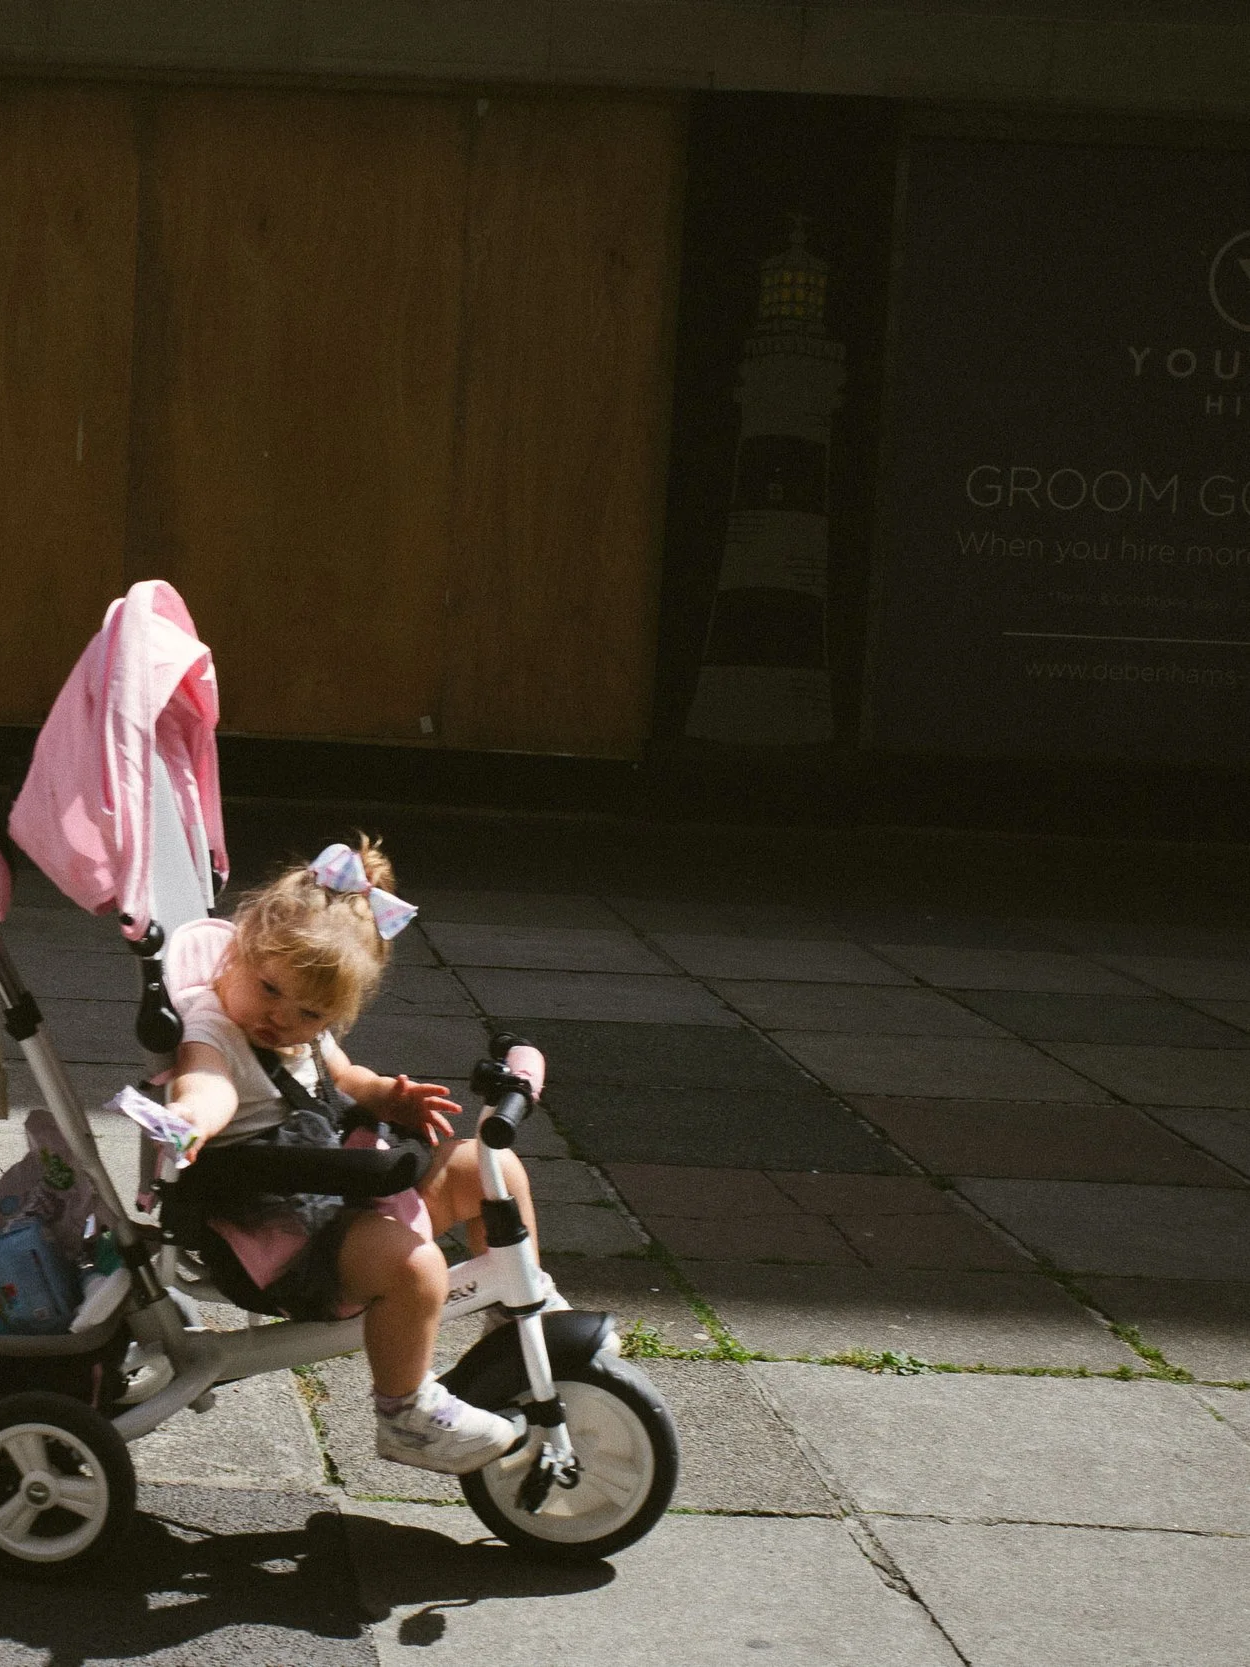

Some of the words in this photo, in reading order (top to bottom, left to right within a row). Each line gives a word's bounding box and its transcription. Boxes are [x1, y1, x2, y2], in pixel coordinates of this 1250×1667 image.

[965, 464, 1180, 514] GROOM
[1199, 473, 1250, 518] G
[956, 530, 1045, 558] When
[1053, 539, 1110, 565] you
[1120, 535, 1176, 564] hire
